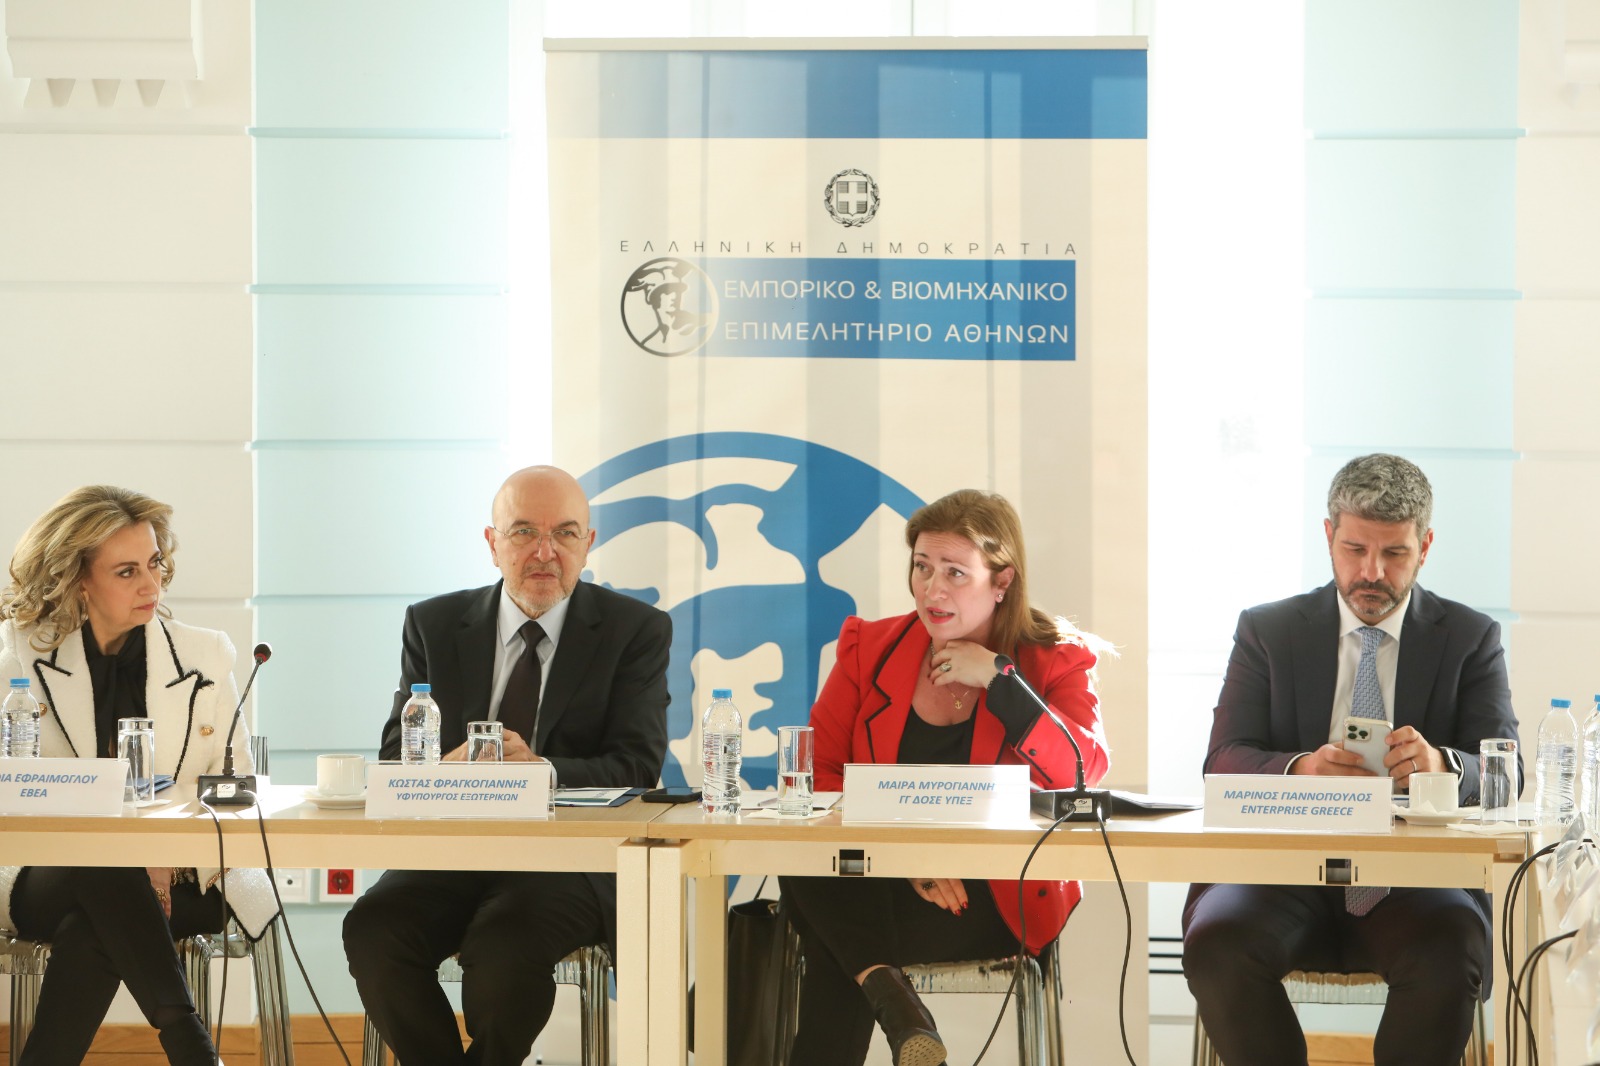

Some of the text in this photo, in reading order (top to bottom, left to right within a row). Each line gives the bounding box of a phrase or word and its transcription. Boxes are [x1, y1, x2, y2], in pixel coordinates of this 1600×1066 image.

[620, 240, 1076, 255] ΕΛΛΗΝΙΚΗ ΔΗΜΟΚΡΑΤΙΑ
[724, 280, 1068, 301] ΕΜΠΟΡΙΚΟ & ΒΙΟΜΗΧΑΝΙΚΟ
[725, 322, 1068, 343] ΕΠΙΜΕΛΗΤΗΡΙΟ ΑΘΗΝΩΝ
[0, 773, 98, 784] ΙΑ ΕΦΡΑΙΜΟΓΛΟΥ
[388, 778, 528, 789] ΚΩΣΤΑΣ ΦΡΑΓΚΟΓΙΑΝΝΗΣ
[877, 780, 996, 791] ΜΑΙΡΑ ΜΥΡΟΓΙΑΝΝΗ
[20, 788, 47, 798] ΕΒΕΑ
[396, 792, 518, 801] ΥΦΥΠΟΥΡΓΟΣ ΕΞΩΤΕΡΙΚΩΝ
[1223, 790, 1372, 802] ΜΑΡΙΝΟΣ ΓΙΑΝΝΟΠΟΥΛΟΣ
[898, 795, 974, 805] ΓΓ ΔΟΣΕ ΥΠΕΞ
[1240, 805, 1353, 816] ENTERPRISE GREECE
